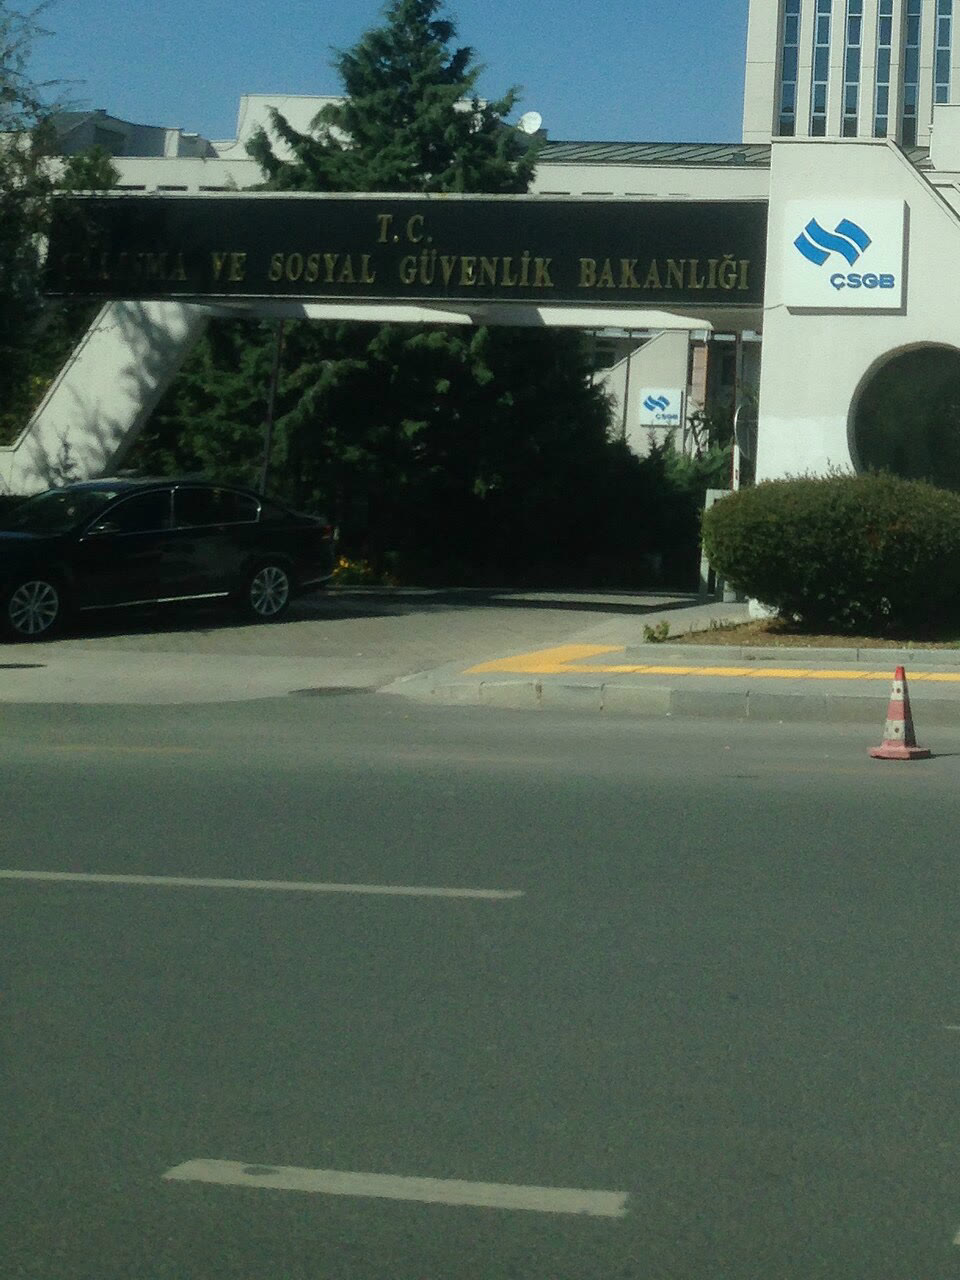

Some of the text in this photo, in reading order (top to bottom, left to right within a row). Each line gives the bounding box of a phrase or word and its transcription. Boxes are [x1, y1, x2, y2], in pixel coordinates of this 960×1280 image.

[376, 214, 433, 244] T.C.
[211, 252, 248, 282] VE
[268, 252, 377, 284] SOSYAL
[400, 249, 555, 288] GÜVENLİK
[578, 253, 751, 291] BAKANLIĞI
[829, 272, 896, 291] ÇSGB
